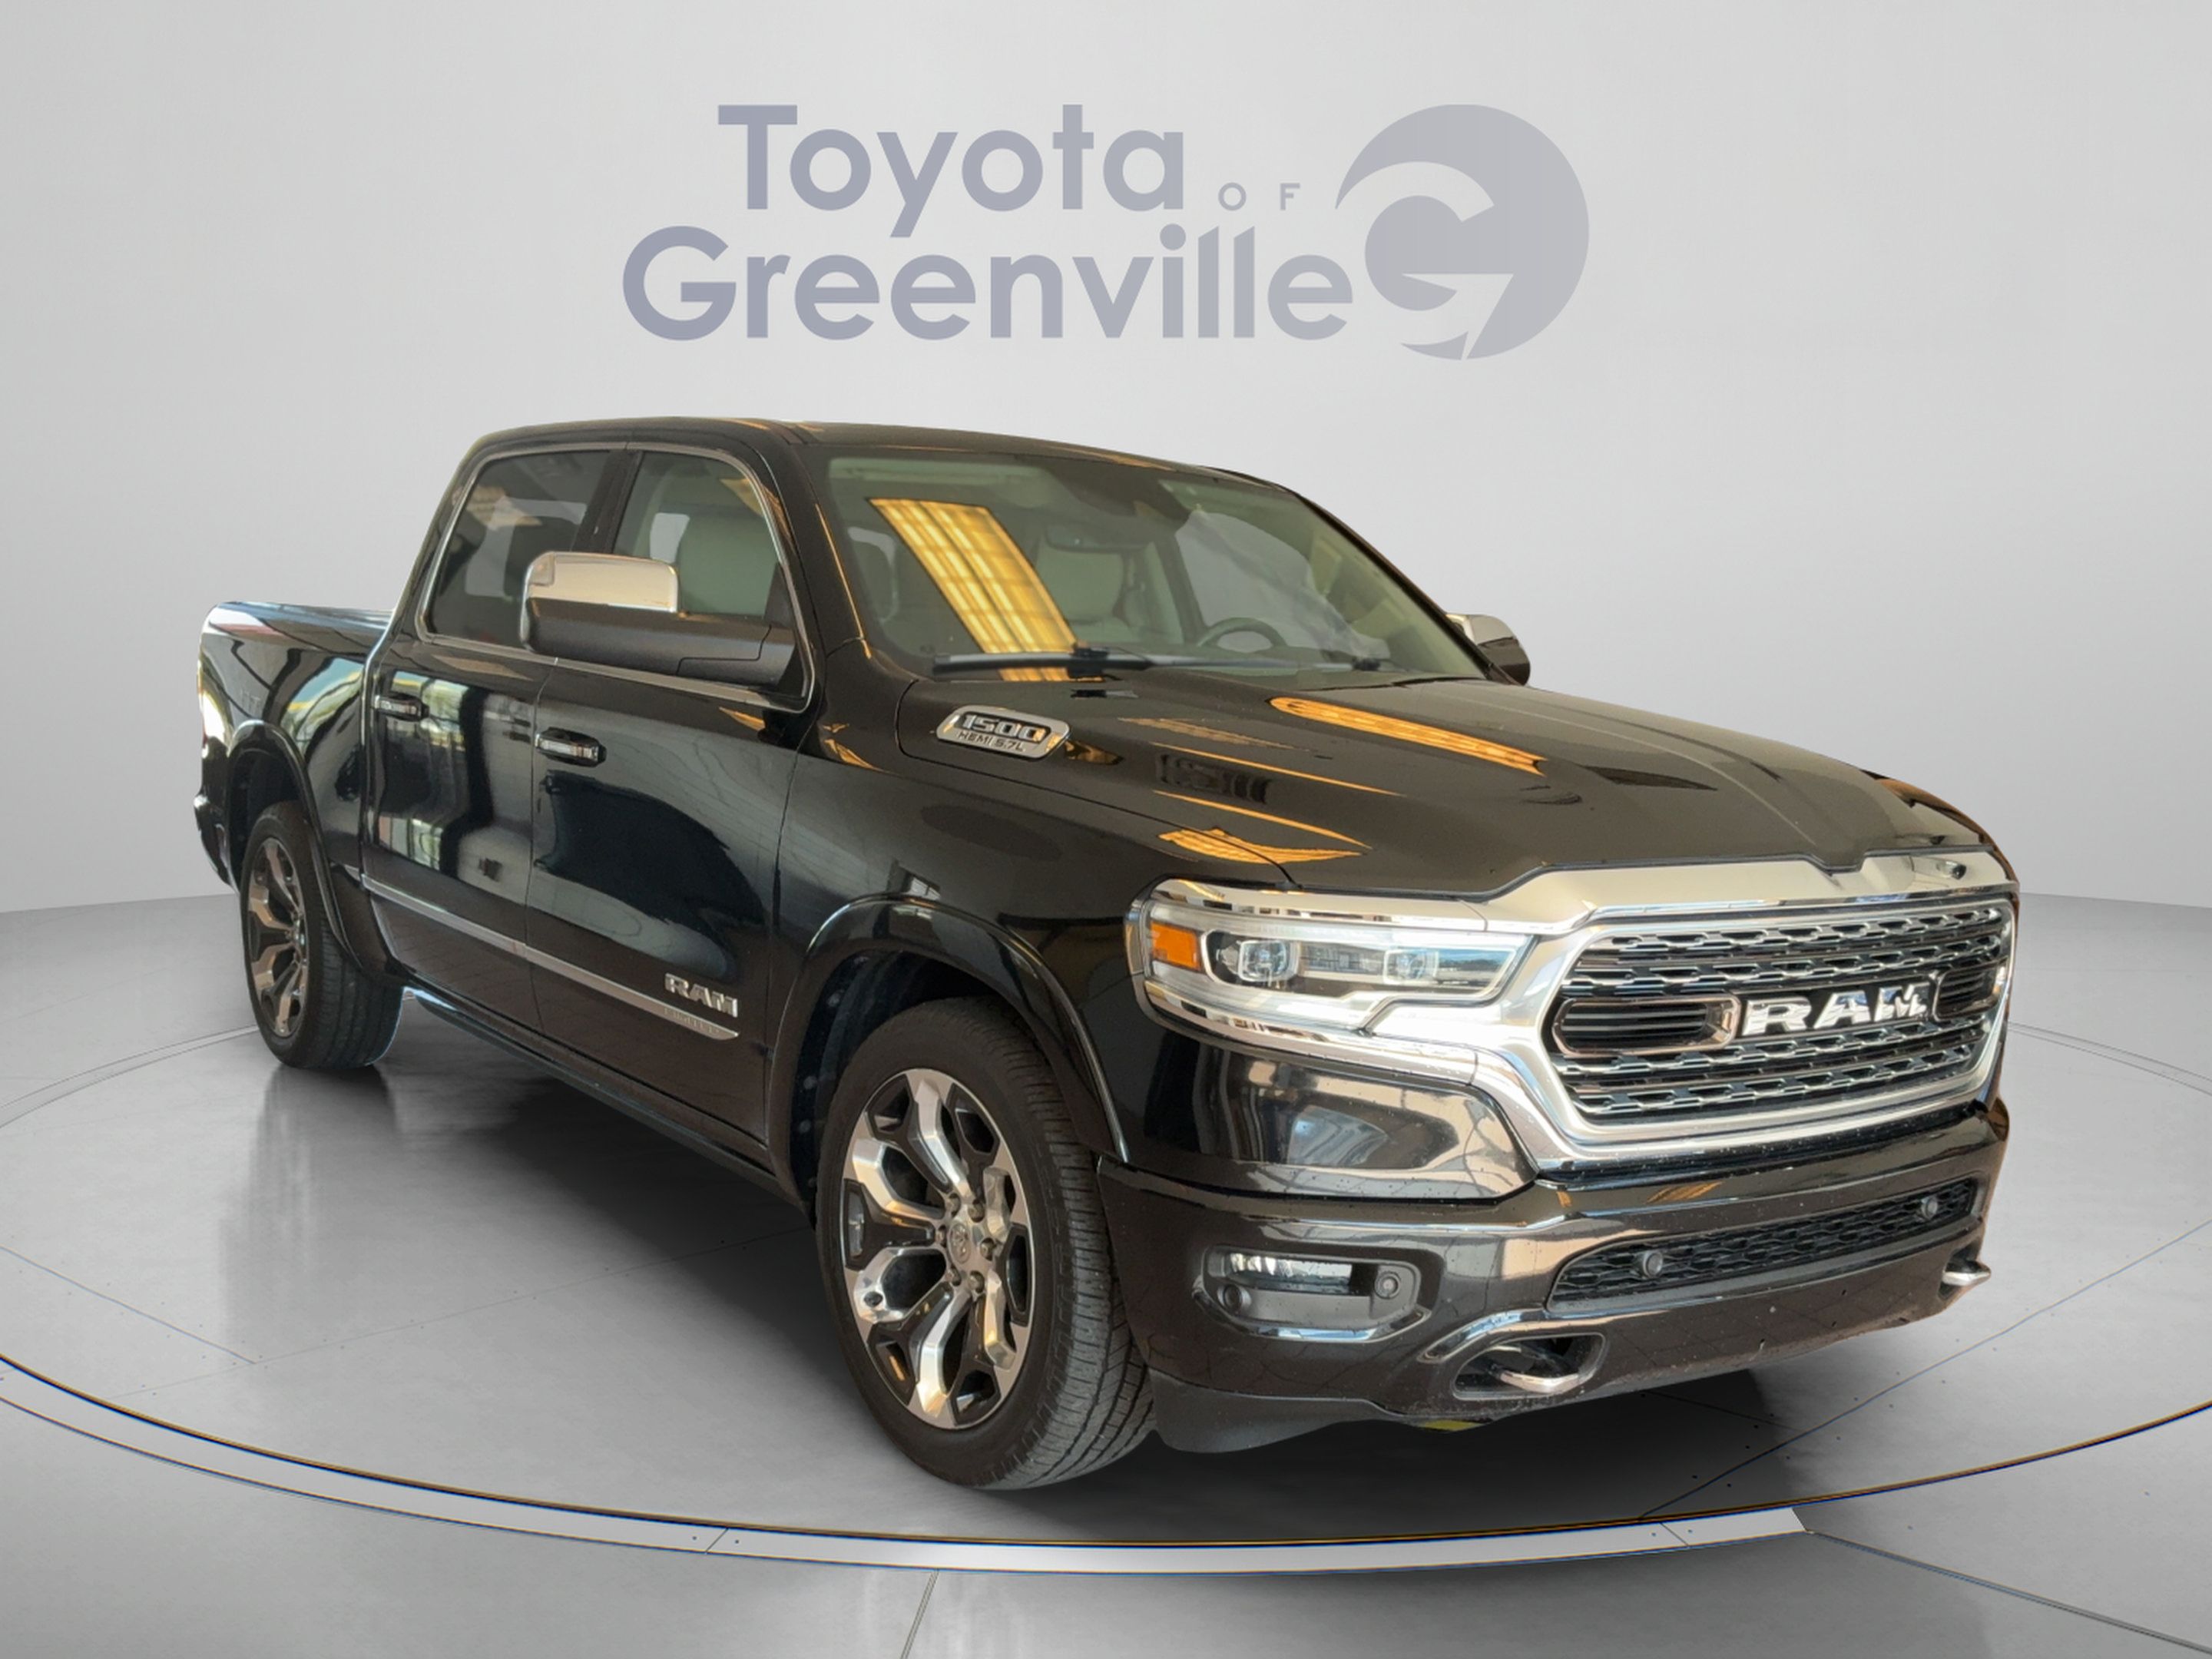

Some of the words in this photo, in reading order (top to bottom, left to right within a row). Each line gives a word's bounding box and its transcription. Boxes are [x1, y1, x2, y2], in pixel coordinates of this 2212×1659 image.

[718, 104, 1184, 238] Toyota
[1218, 182, 1300, 211] OF
[622, 224, 1353, 341] Greenville
[959, 730, 992, 746] HEMI
[995, 737, 1024, 752] 5.7L
[962, 714, 1047, 743] 1500
[664, 972, 738, 1018] RAM
[1741, 982, 1931, 1037] RAM
